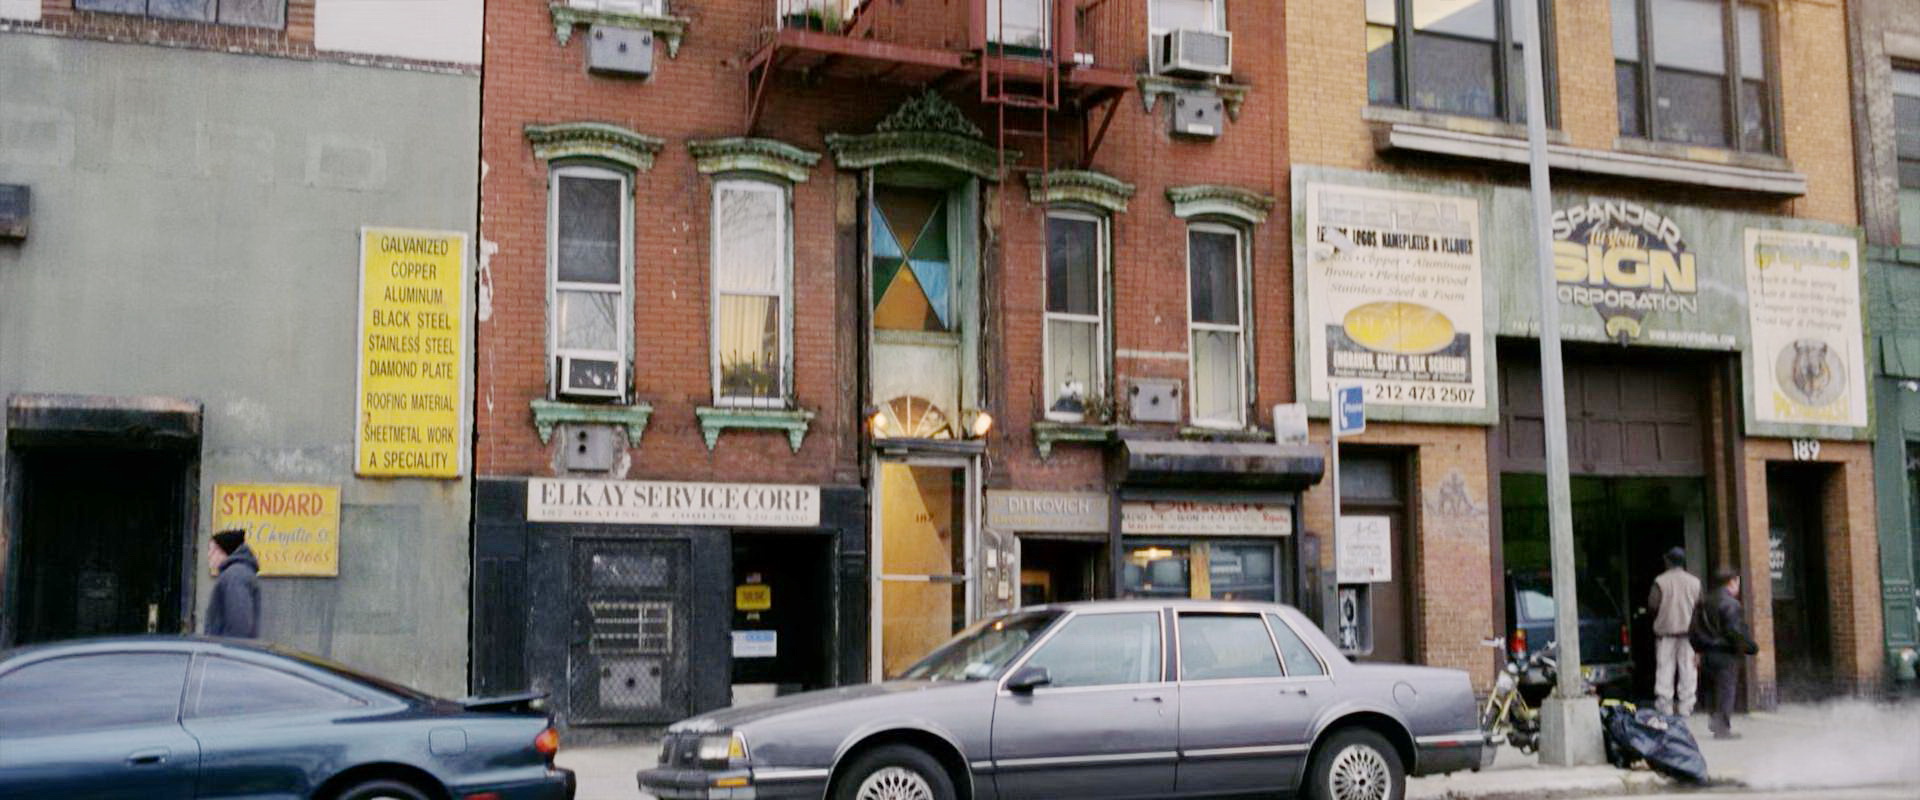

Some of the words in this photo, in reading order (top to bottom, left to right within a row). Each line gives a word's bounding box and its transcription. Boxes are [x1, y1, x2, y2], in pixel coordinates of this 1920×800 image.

[381, 236, 448, 255] GALVANIZED
[1381, 233, 1429, 251] NAMEPLATES
[391, 262, 436, 279] COPPER
[1361, 254, 1400, 267] Copper
[1413, 259, 1471, 271] Aluminum
[1552, 239, 1696, 293] SIGN
[1325, 266, 1366, 277] Bronze
[1436, 275, 1467, 286] Wood
[384, 287, 442, 304] ALUMINUM
[1331, 283, 1382, 295] Stainless
[1388, 287, 1415, 297] Steel
[1433, 290, 1464, 302] Foam
[1557, 286, 1697, 314] ORPORATION
[373, 311, 410, 328] BLACK
[417, 313, 451, 329] STEEL
[369, 335, 419, 353] STAINLESS
[425, 336, 454, 354] STEEL
[370, 361, 416, 377] DIAMOND
[422, 363, 453, 380] PLATE
[367, 393, 407, 408] ROOFING
[411, 394, 454, 411] MATERIAL
[1375, 384, 1402, 398] 212
[1408, 385, 1436, 400] 473
[1440, 388, 1474, 403] 2507
[364, 424, 421, 443] SHEETMETAL
[427, 427, 454, 443] WORK
[1793, 439, 1820, 460] 189
[369, 452, 377, 468] A
[384, 452, 448, 468] SPECIALITY
[222, 492, 325, 516] STANDARD
[540, 482, 629, 506] ELKAY
[632, 485, 739, 510] SERVICE
[742, 488, 810, 512] CORP.
[1008, 496, 1089, 513] DITKOVICH
[671, 512, 735, 520] COOLING
